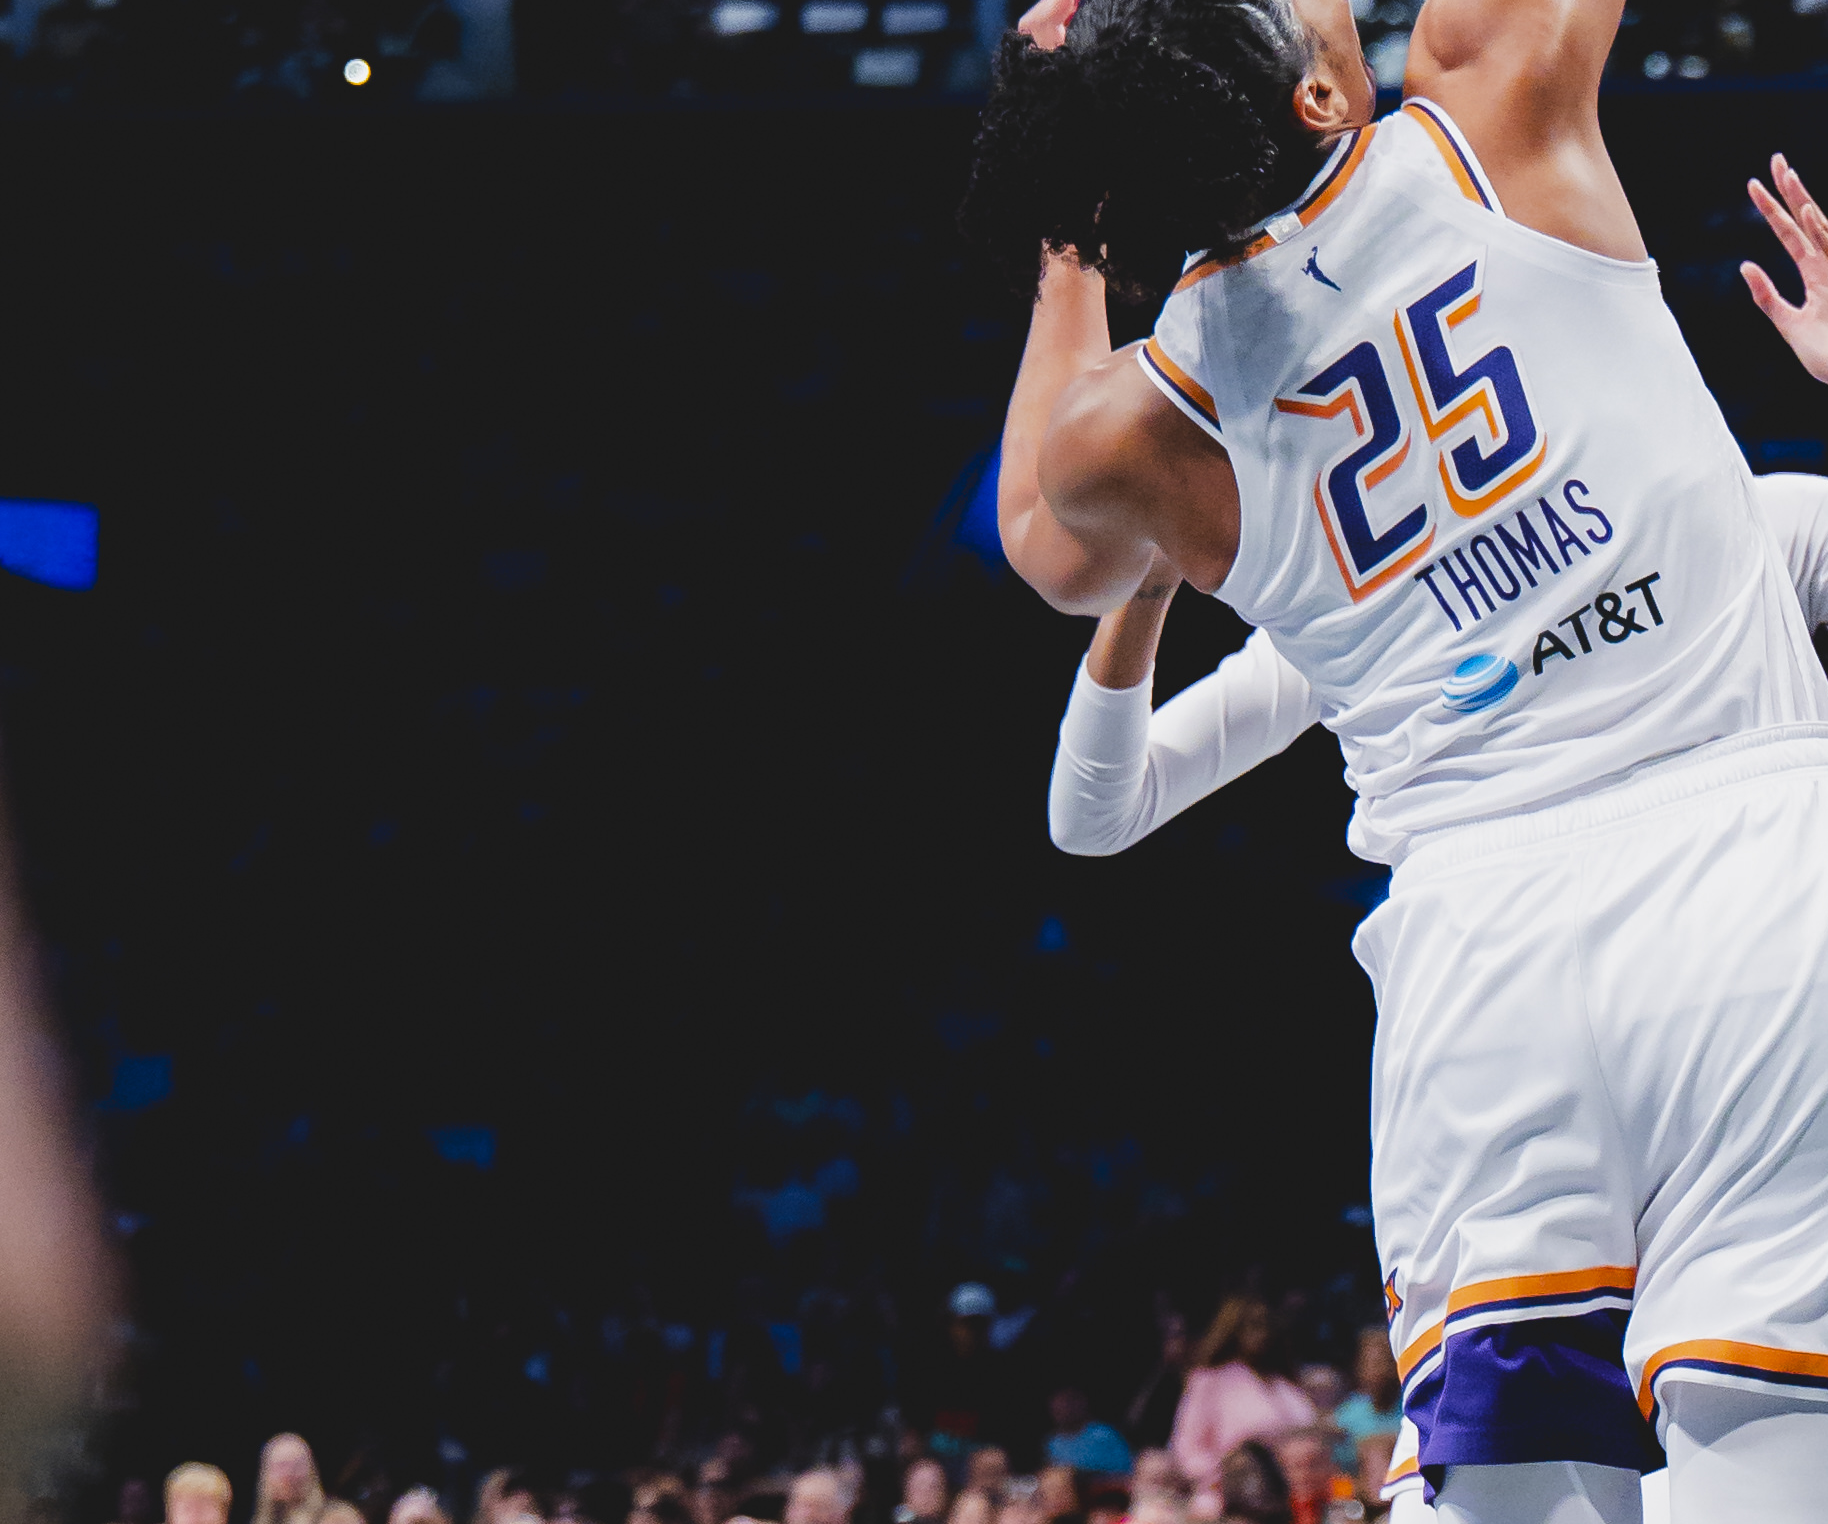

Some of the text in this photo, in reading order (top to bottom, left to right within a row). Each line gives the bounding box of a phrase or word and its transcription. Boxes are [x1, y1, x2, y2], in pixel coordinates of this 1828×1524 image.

[1276, 249, 1547, 604] 25
[1414, 479, 1613, 632] THOMAS
[1532, 571, 1664, 676] AT&T
